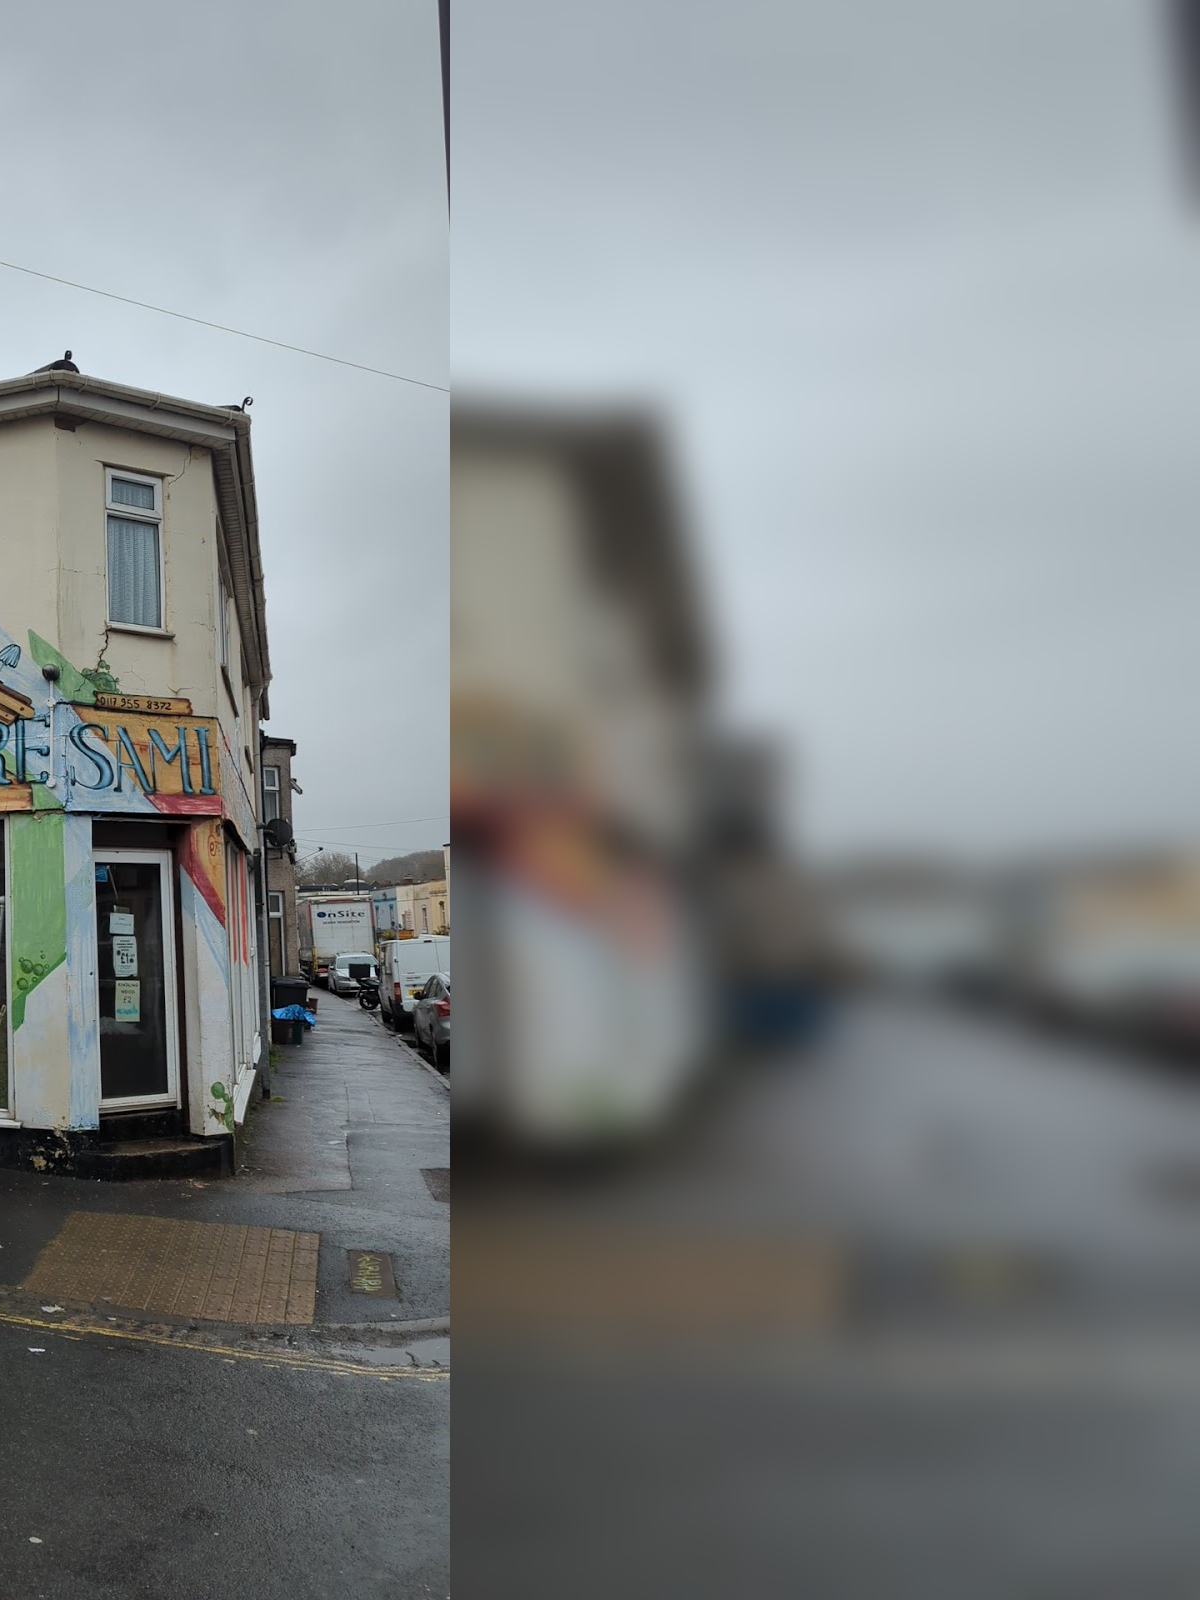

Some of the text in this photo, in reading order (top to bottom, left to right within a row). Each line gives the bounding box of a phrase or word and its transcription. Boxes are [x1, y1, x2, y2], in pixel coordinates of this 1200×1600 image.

[100, 696, 172, 711] 0117 955 8372
[68, 721, 217, 796] SAMI
[316, 910, 366, 918] OnSite
[123, 995, 133, 1004] £2
